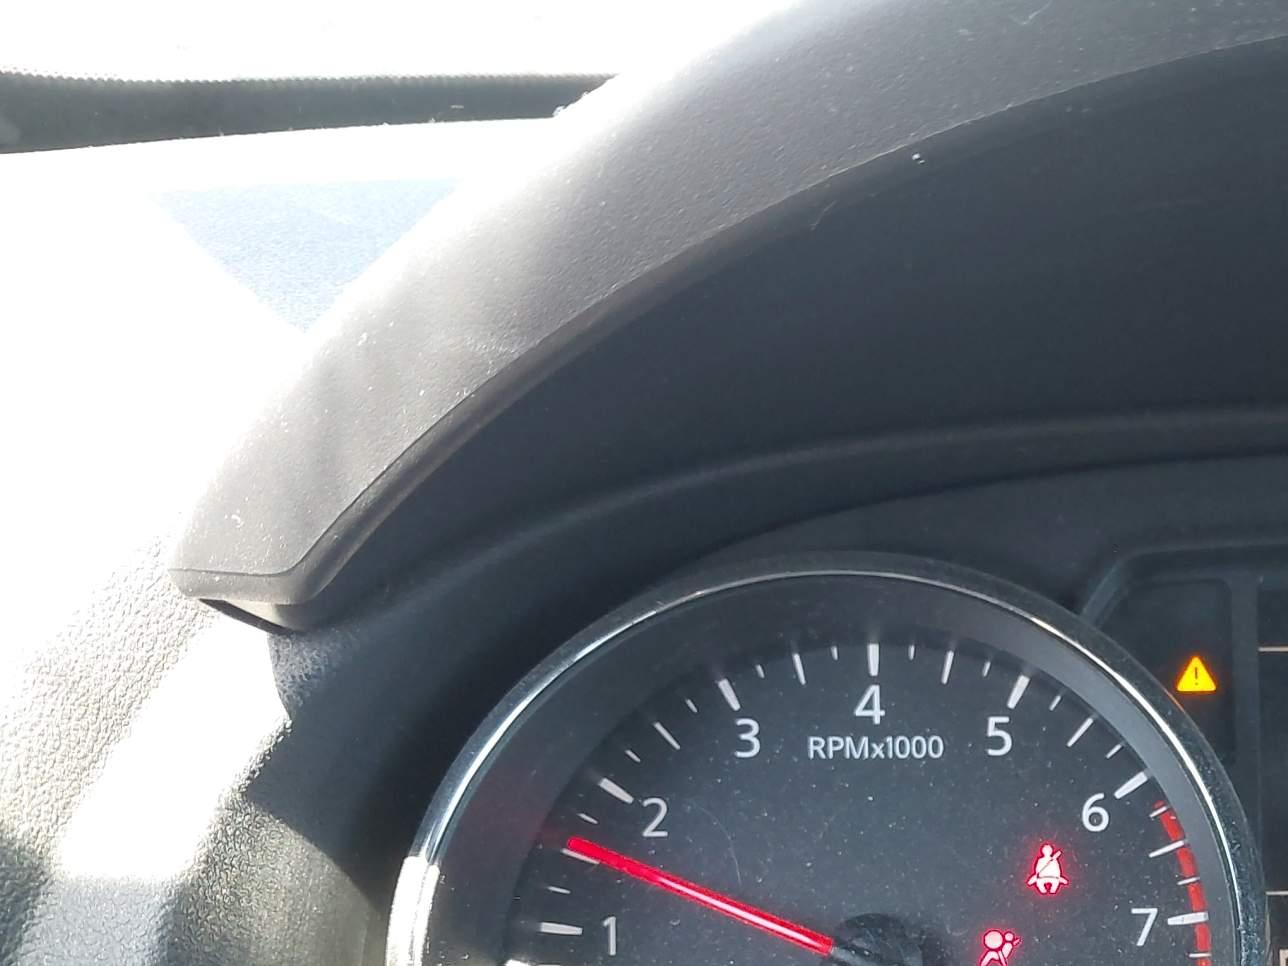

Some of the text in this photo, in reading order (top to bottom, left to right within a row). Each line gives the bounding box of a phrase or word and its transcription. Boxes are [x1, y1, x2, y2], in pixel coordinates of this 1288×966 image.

[855, 685, 885, 724] 4
[736, 719, 760, 758] 3
[808, 735, 944, 759] RPMx1000
[987, 716, 1012, 756] 5
[642, 798, 668, 838] 2
[1082, 793, 1109, 831] 6
[603, 916, 616, 955] 1
[1131, 907, 1158, 946] 7
